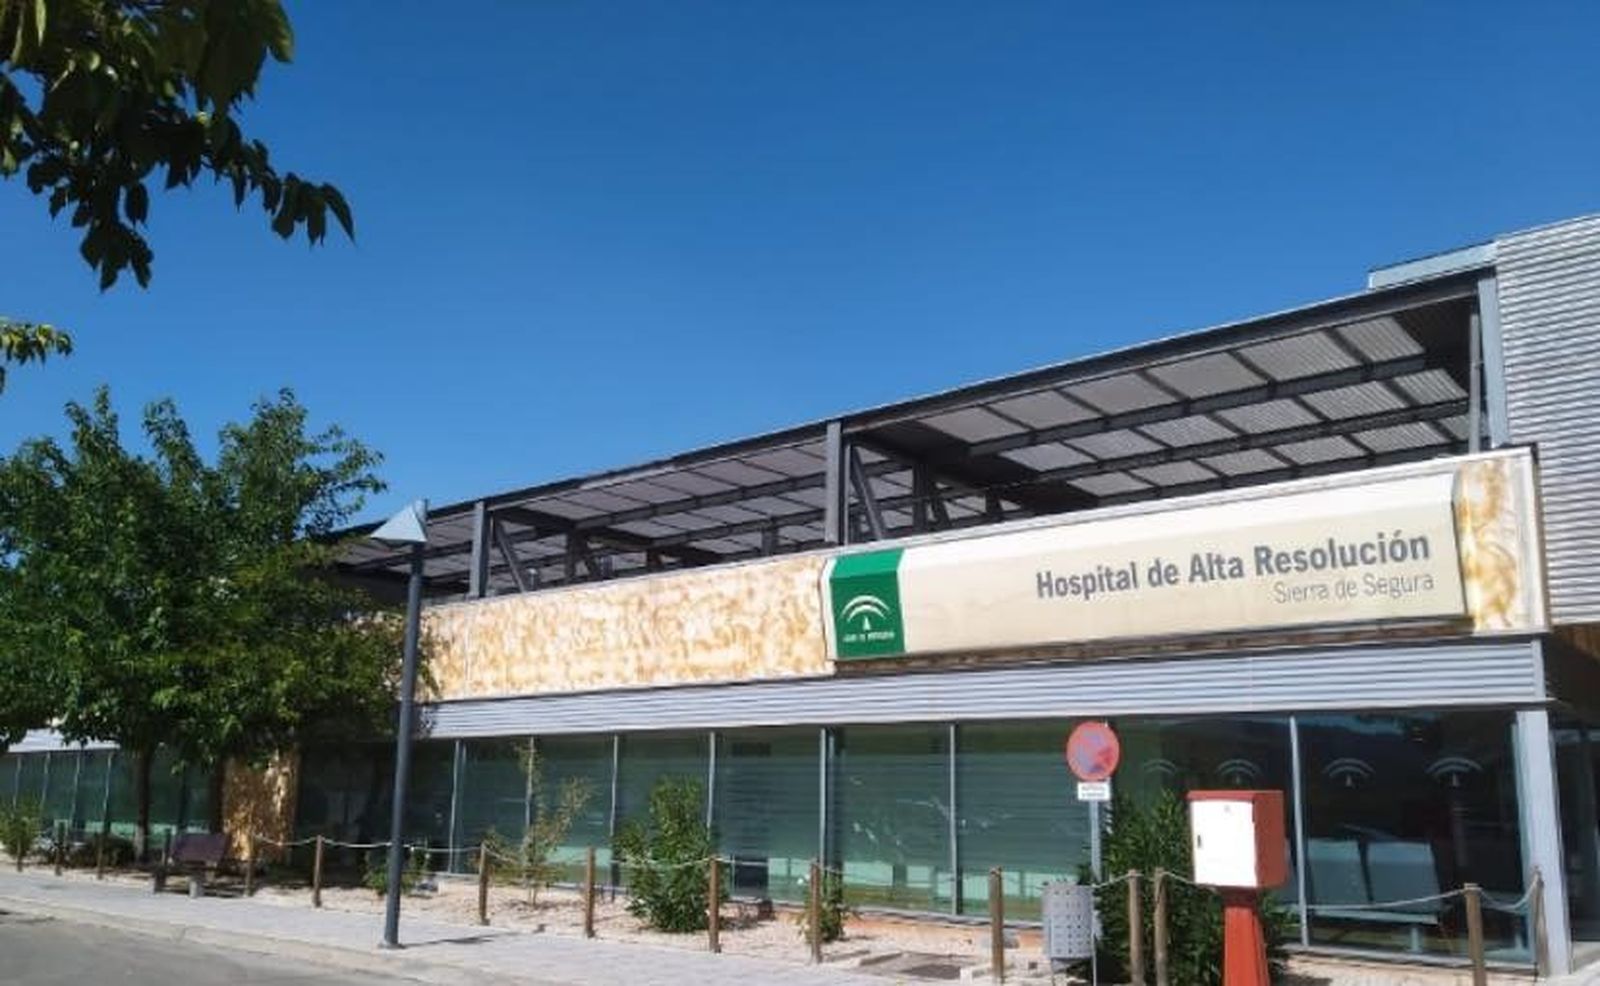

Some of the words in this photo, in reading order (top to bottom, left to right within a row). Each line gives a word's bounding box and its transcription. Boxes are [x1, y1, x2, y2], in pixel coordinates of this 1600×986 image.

[1036, 561, 1139, 600] Hospital
[1148, 558, 1179, 587] de
[1188, 553, 1245, 582] Alta
[1253, 530, 1431, 576] Resolución
[1273, 580, 1329, 603] Sierra
[1335, 579, 1358, 599] de
[1362, 573, 1434, 599] Segura
